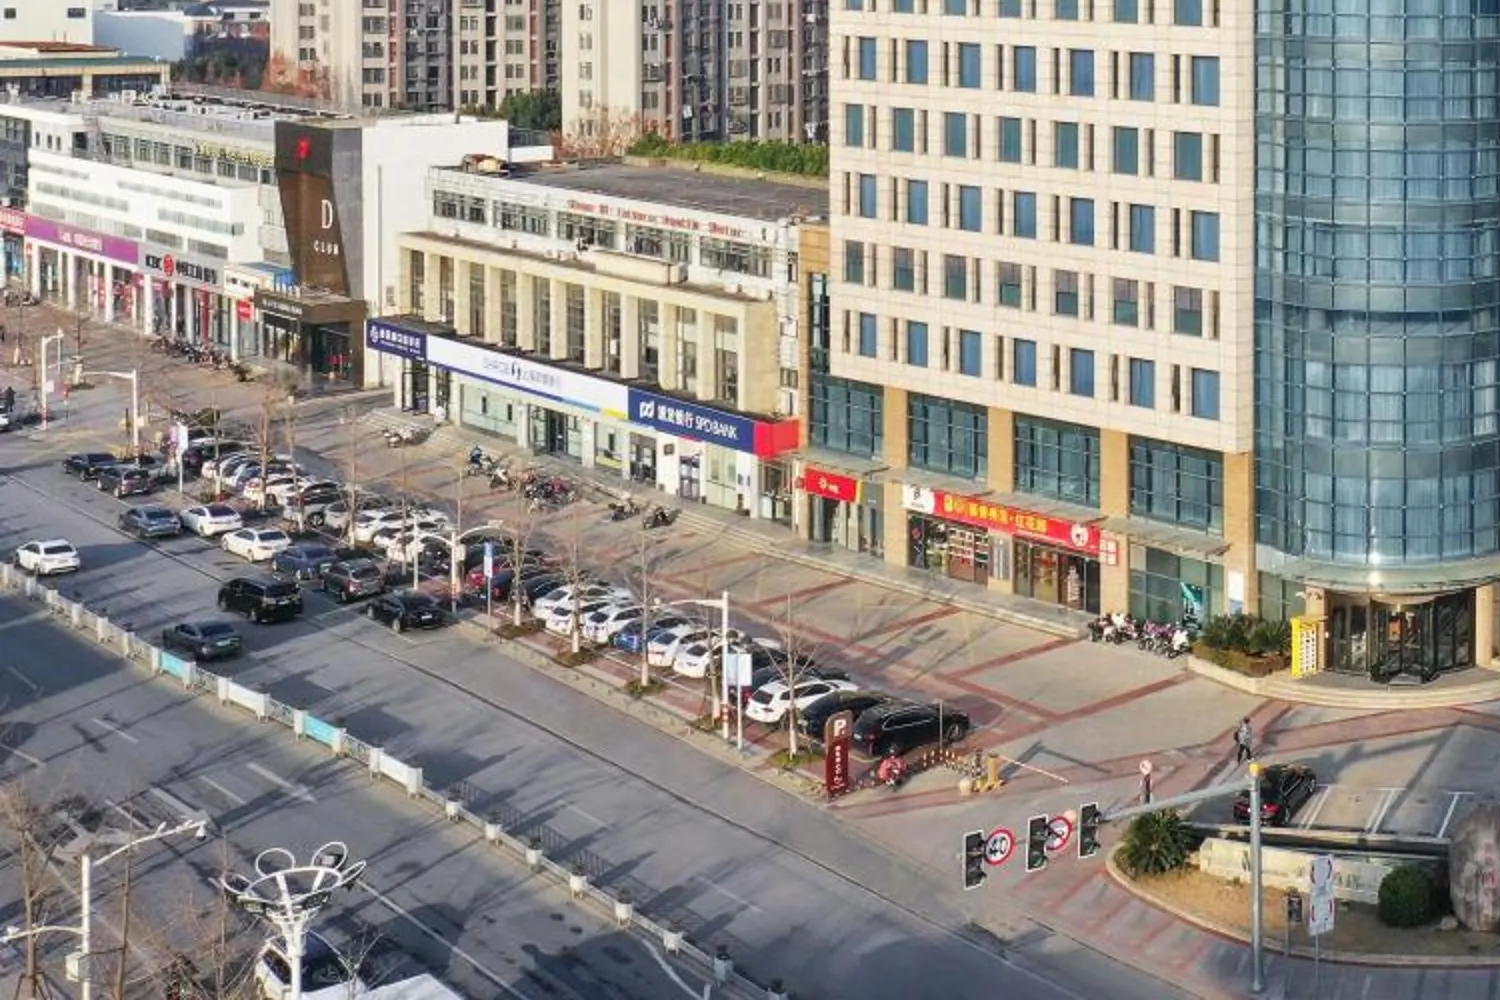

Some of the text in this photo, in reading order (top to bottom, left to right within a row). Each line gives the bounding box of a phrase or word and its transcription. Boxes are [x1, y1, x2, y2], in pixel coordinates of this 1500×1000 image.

[321, 199, 334, 229] D
[833, 719, 847, 737] P
[988, 836, 1007, 857] 40
